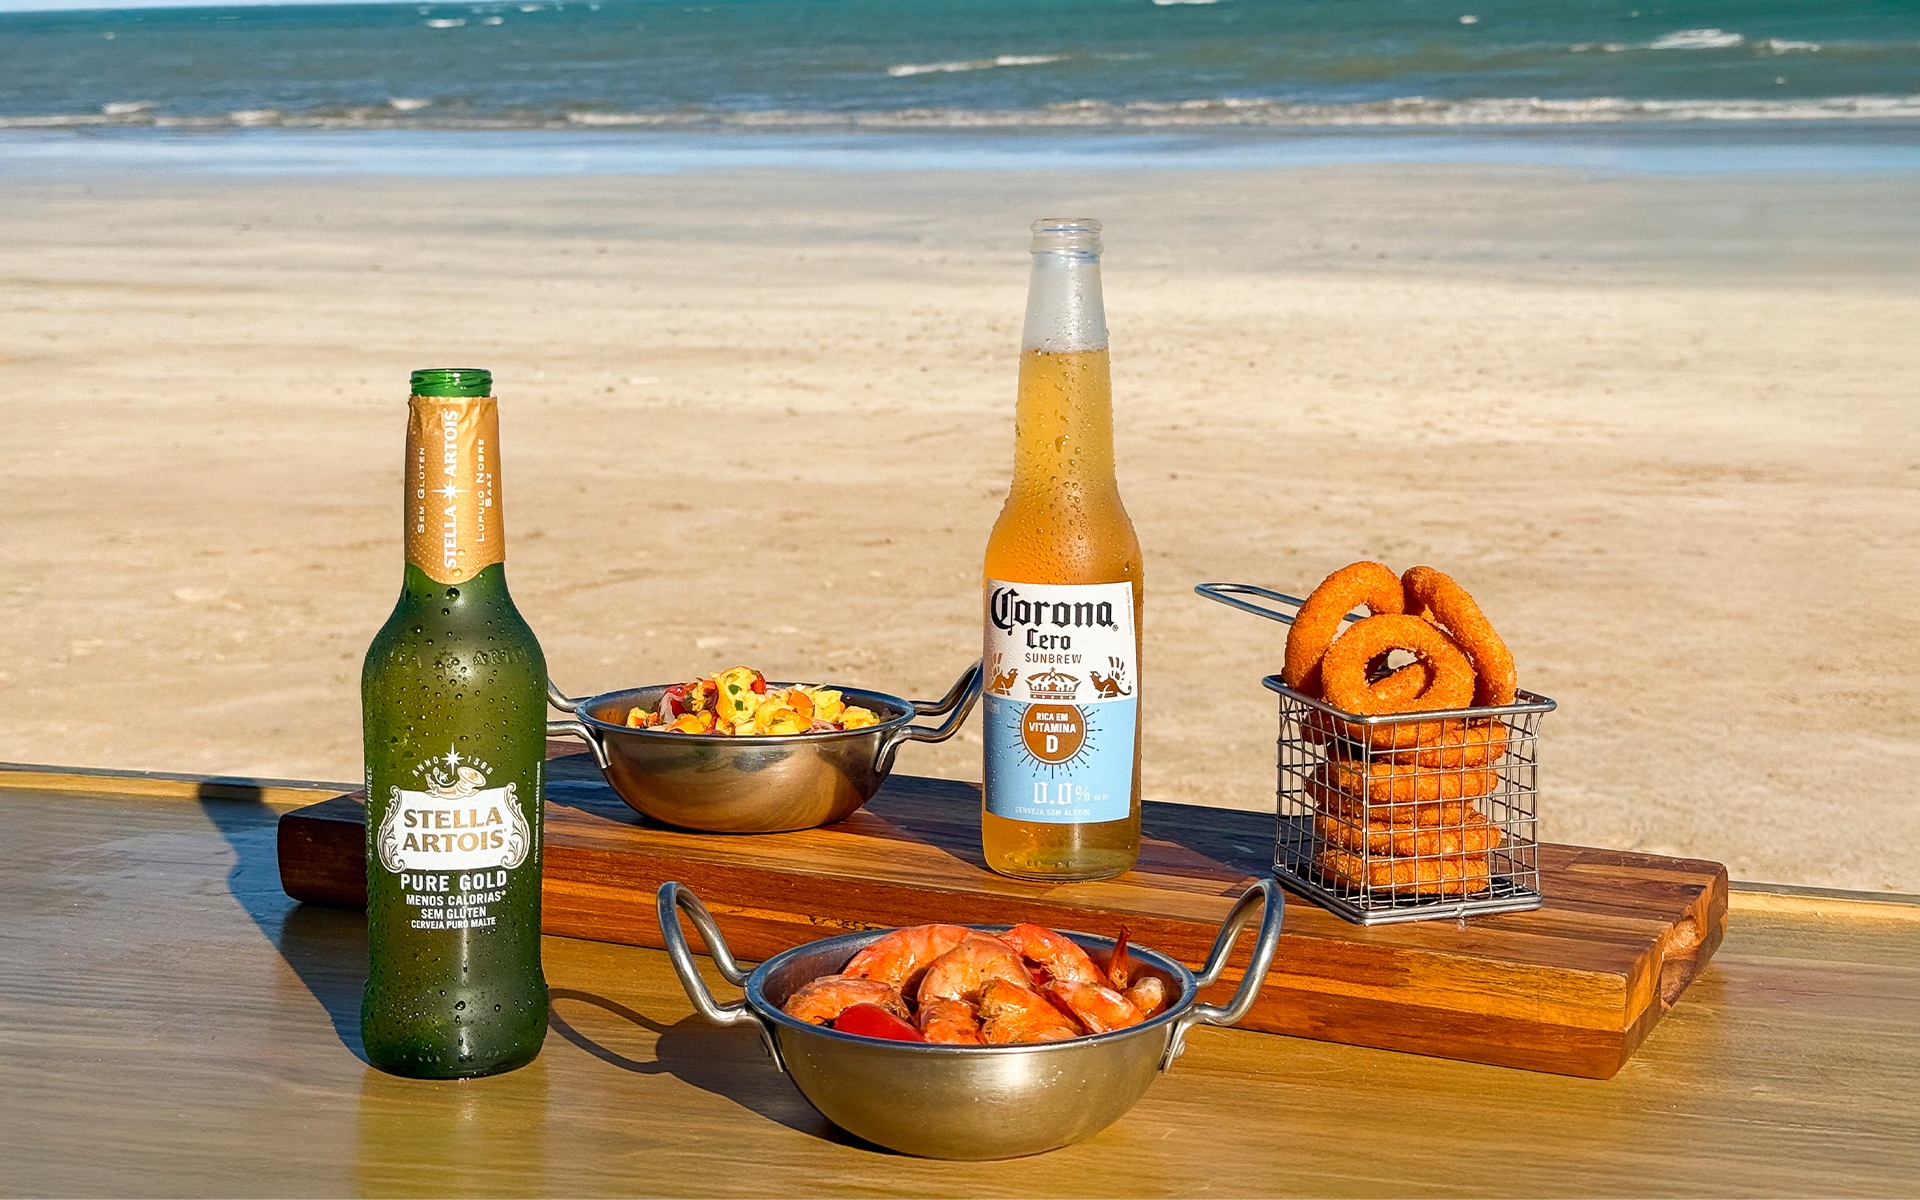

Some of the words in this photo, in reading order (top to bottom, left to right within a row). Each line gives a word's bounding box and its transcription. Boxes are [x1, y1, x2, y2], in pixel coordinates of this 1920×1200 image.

[443, 409, 458, 477] ARTOIS
[443, 505, 457, 568] STELLA
[1026, 628, 1071, 650] Cero
[1025, 652, 1082, 664] SUNBREW
[1036, 712, 1053, 721] RICA
[1056, 712, 1068, 721] EM
[1029, 722, 1077, 734] VITAMINA
[1046, 734, 1059, 753] D
[411, 755, 440, 778] ANNO
[1033, 781, 1090, 805] 0.0%
[403, 806, 504, 829] STELLA
[1015, 806, 1045, 816] CERVEJA
[1047, 808, 1061, 816] SEM
[402, 829, 505, 852] ARTOIS
[401, 873, 449, 892] PURE
[459, 870, 507, 891] GOLD
[406, 894, 444, 906] MENOS
[411, 919, 444, 929] CERVEJA
[446, 920, 468, 929] PURO
[471, 917, 496, 928] MALTE
[421, 908, 443, 919] SEM
